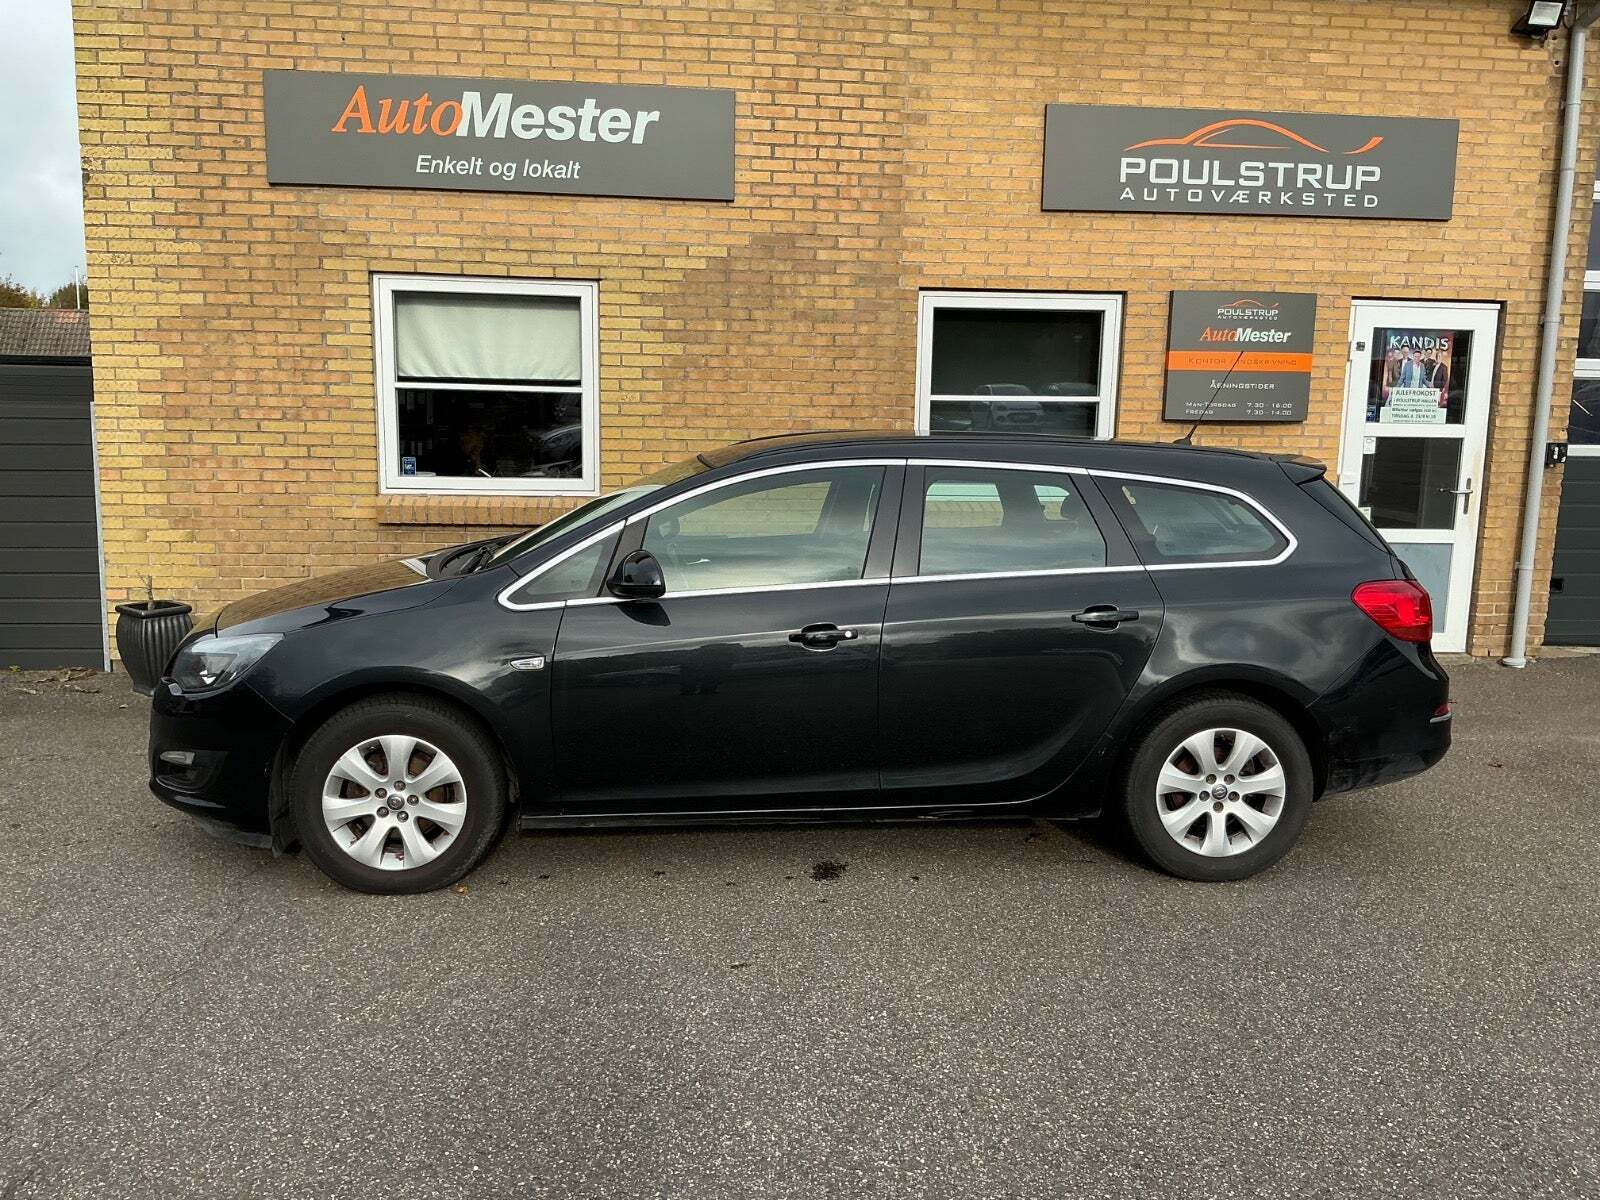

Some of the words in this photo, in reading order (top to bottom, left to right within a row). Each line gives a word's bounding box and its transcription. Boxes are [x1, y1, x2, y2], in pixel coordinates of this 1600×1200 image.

[331, 84, 659, 145] AutoMester
[415, 154, 482, 175] Enkelt
[488, 159, 516, 181] og
[522, 158, 581, 179] lokalt
[1118, 157, 1381, 191] POULSTRUP
[1119, 187, 1379, 208] AUTOVÆRKSTED
[1217, 308, 1279, 317] POULSTRUP
[1200, 326, 1292, 343] AutoMester
[1389, 335, 1450, 351] KANDIS
[1188, 357, 1226, 366] KONTOR
[1209, 379, 1275, 390] ÅBNINGSTIDER
